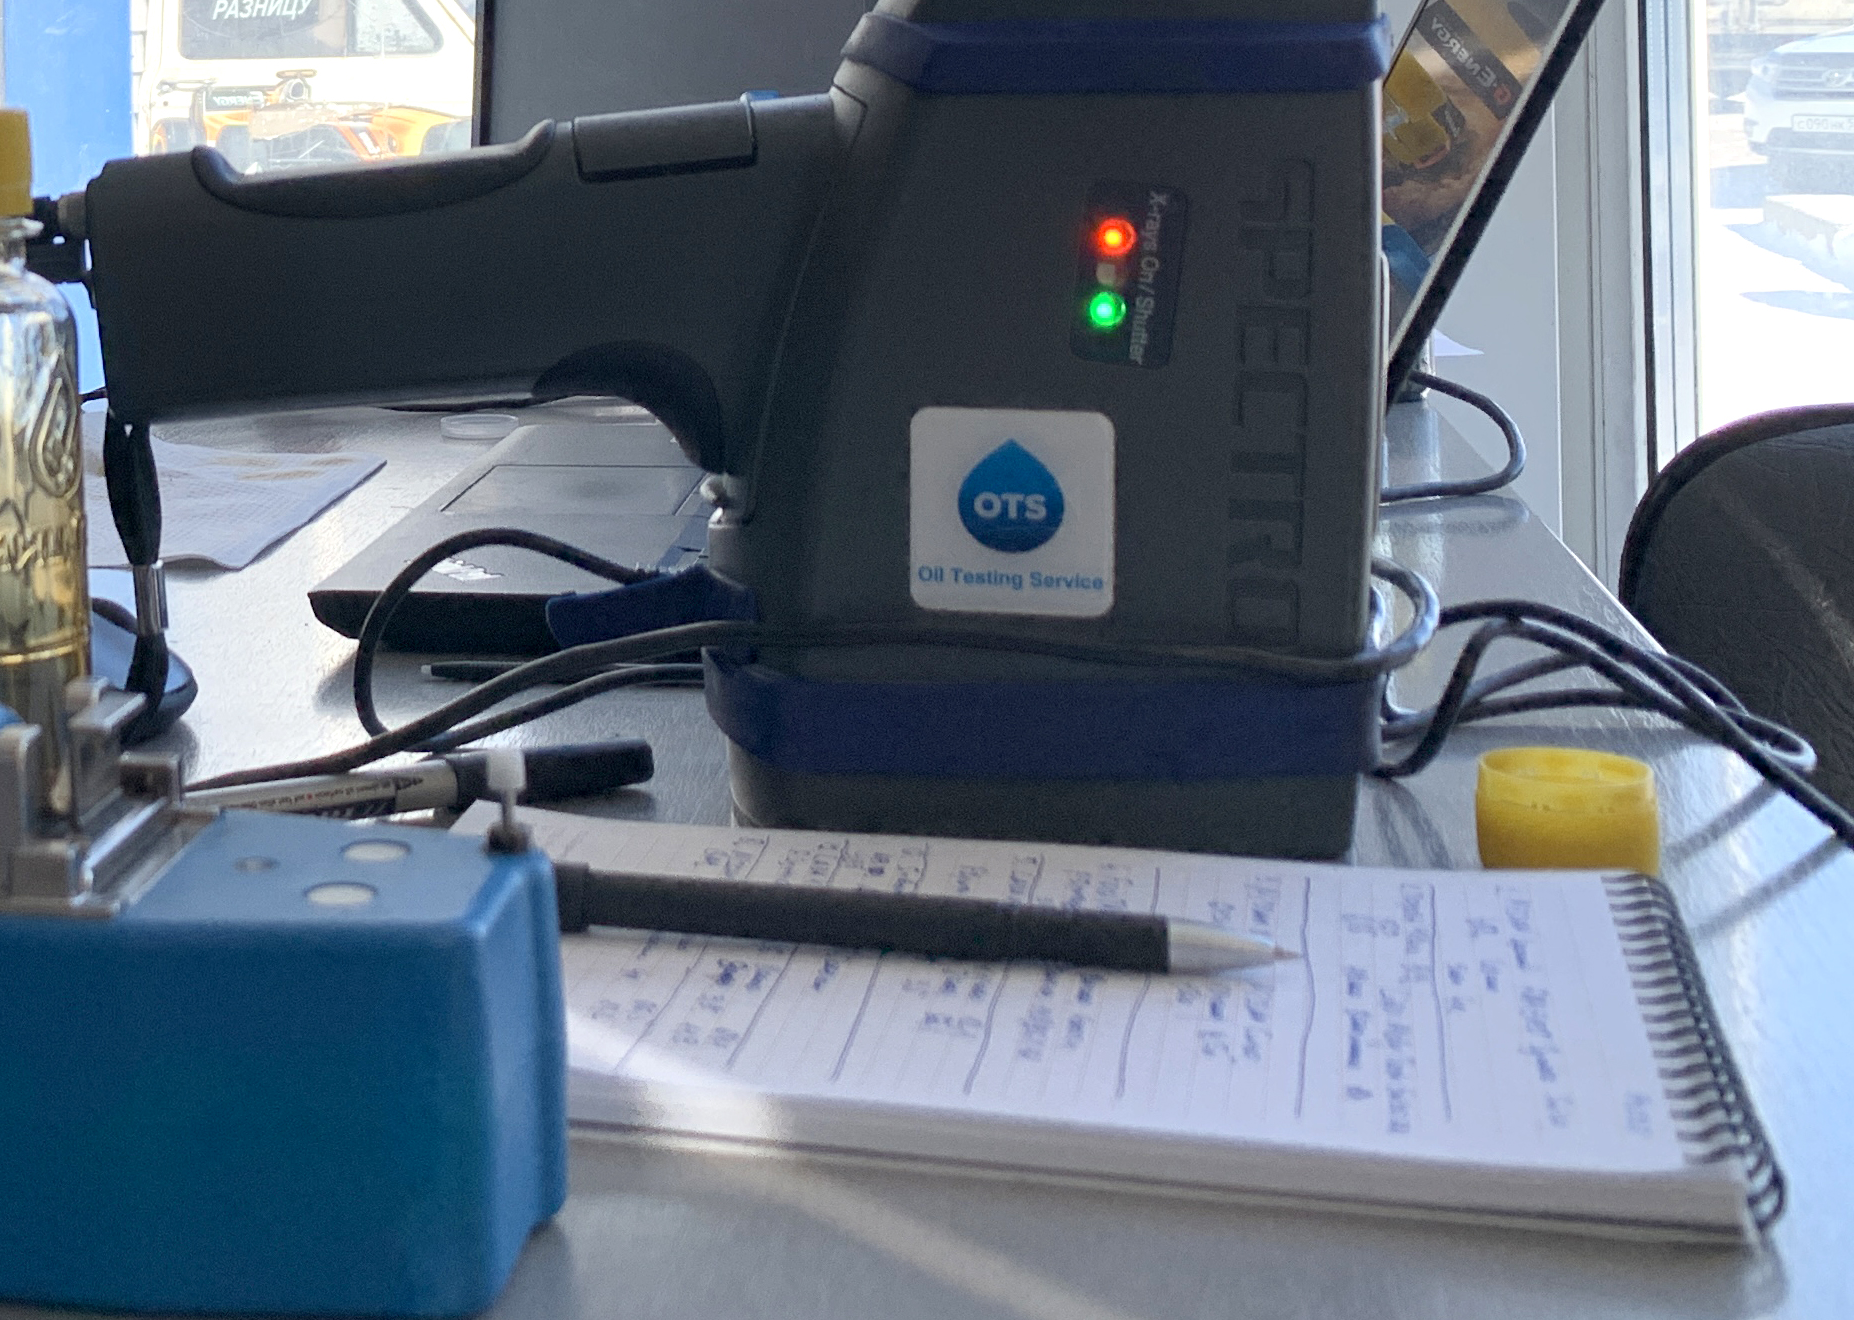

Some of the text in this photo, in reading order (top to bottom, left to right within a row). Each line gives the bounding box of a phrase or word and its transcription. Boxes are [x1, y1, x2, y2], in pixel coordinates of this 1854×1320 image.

[1141, 190, 1168, 252] X-rays
[972, 491, 1048, 521] OTS
[917, 565, 1105, 591] Oil Testing Service
